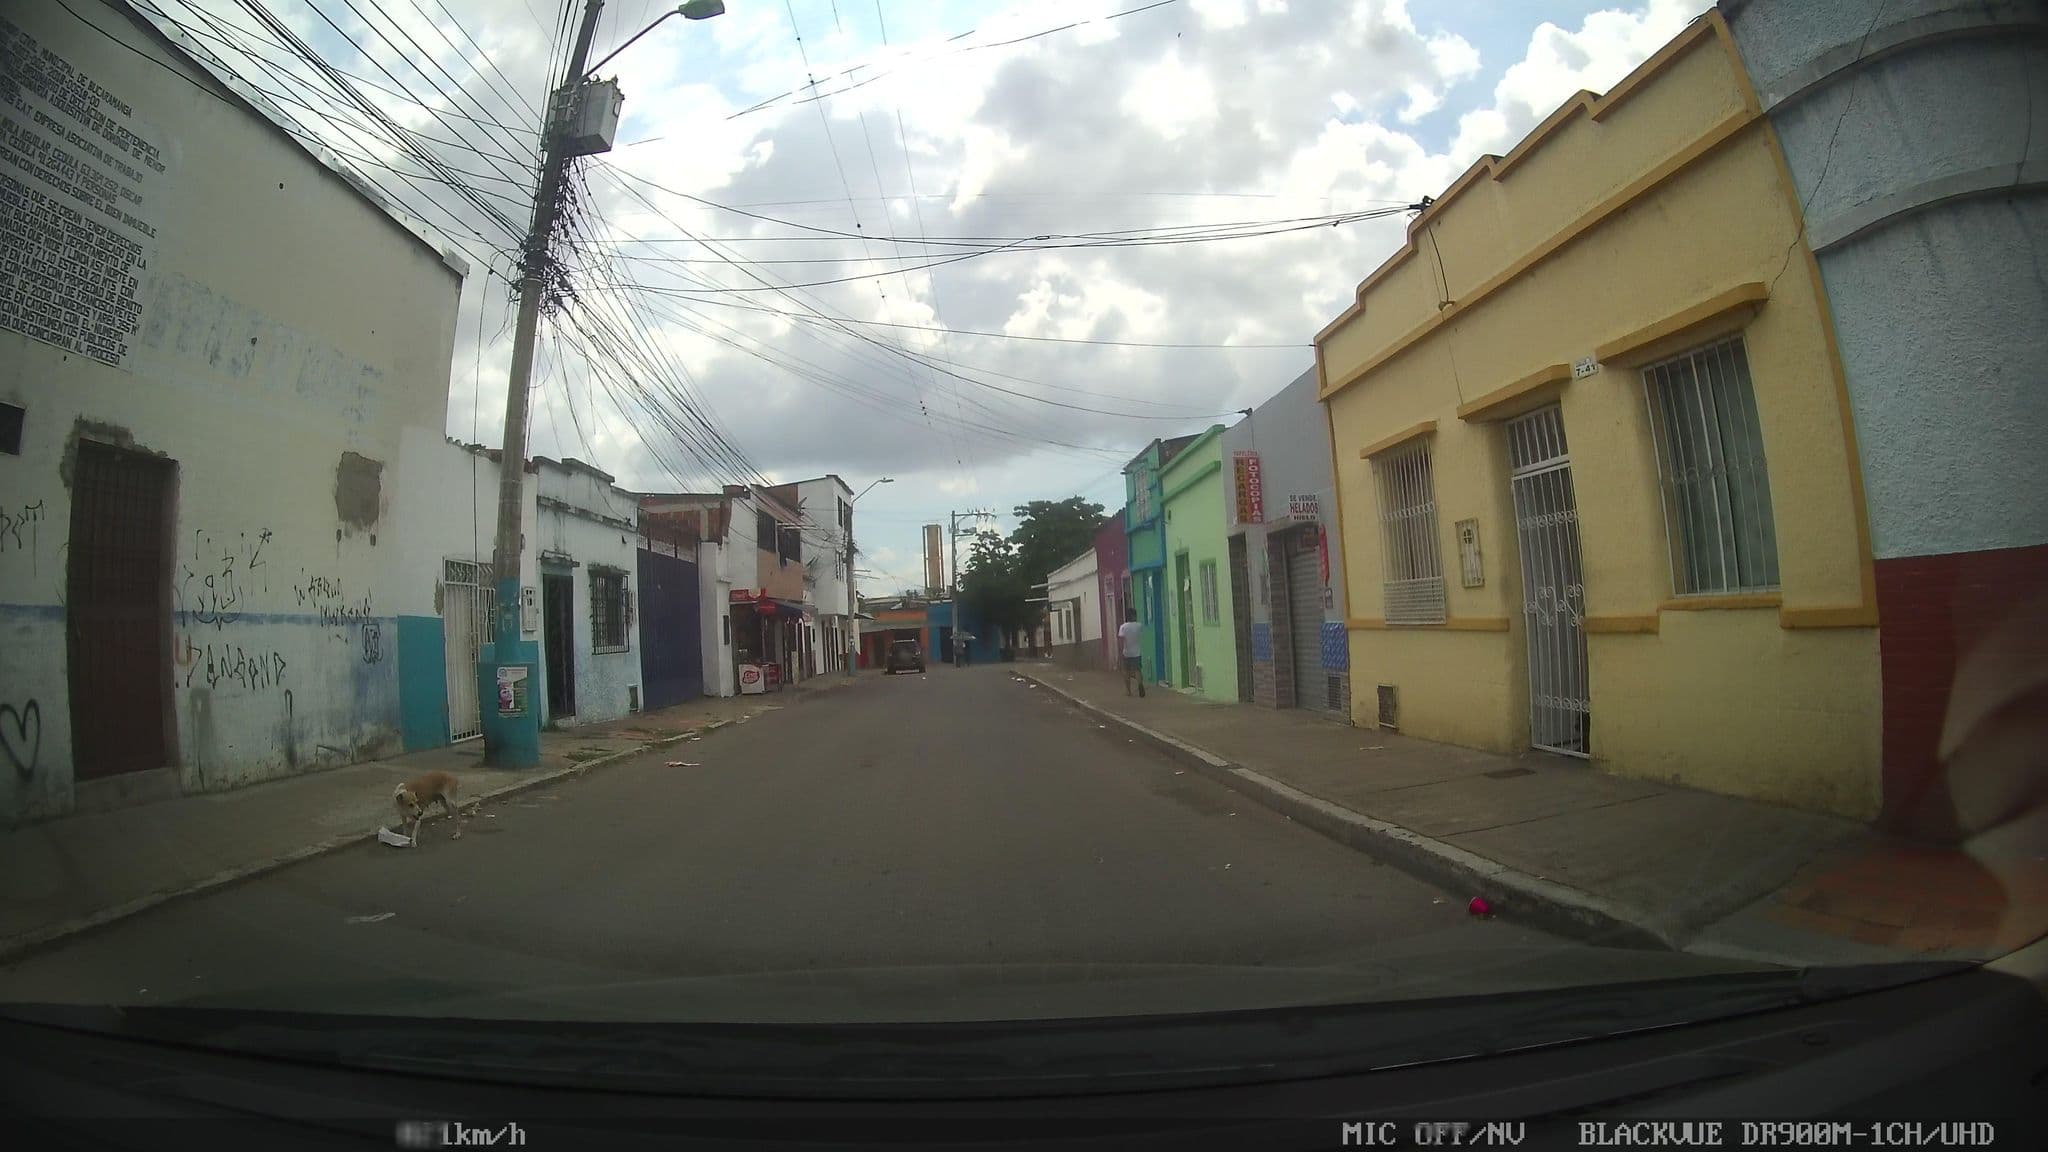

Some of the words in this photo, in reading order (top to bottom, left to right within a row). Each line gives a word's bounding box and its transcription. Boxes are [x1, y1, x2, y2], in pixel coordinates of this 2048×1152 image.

[40, 45, 75, 79] MUNICIPAL
[76, 71, 88, 87] DE
[87, 79, 132, 118] BUCARAMANGA
[58, 85, 70, 102] DE
[105, 116, 116, 132] DE
[8, 133, 36, 159] CEDULA
[74, 171, 81, 184] Y
[80, 174, 117, 205] PERSONAS
[33, 108, 65, 137] EMPRESA
[102, 151, 113, 166] DE
[113, 157, 143, 184] TRABAJO
[52, 146, 79, 170] CEDULA
[91, 119, 102, 135] DE
[131, 146, 142, 160] DE
[18, 156, 35, 175] CON
[33, 164, 72, 194] DERECHOS
[70, 184, 95, 207] SOBRE
[94, 197, 104, 211] EL
[104, 202, 122, 221] BIEN
[12, 207, 65, 242] BUCARAMANGA
[65, 233, 119, 268] DEPARTAMENTO
[119, 260, 130, 274] DE
[29, 202, 49, 222] LOTE
[49, 212, 61, 227] DE
[61, 218, 94, 244] TERRENO
[94, 235, 125, 259] UBICADO
[125, 250, 136, 265] EN
[136, 256, 147, 270] LA
[30, 189, 47, 207] QUE
[46, 197, 58, 213] SE
[58, 203, 82, 225] CREAN
[82, 216, 107, 237] TENER
[106, 228, 143, 256] DERECHOS
[8, 247, 20, 262] EN
[30, 256, 47, 273] MTS
[46, 263, 62, 280] CON
[62, 270, 105, 298] PROPIEDAD
[104, 289, 116, 303] DE
[116, 294, 143, 315] BENITO
[26, 227, 43, 245] QUE
[43, 235, 62, 253] MIDE
[61, 244, 67, 256] Y
[103, 264, 128, 284] NORTE
[127, 275, 138, 289] EN
[34, 245, 41, 258] 7
[40, 247, 46, 260] Y
[45, 250, 56, 265] 10
[57, 255, 79, 274] ESTE
[77, 264, 89, 279] EN
[89, 270, 101, 284] 20
[100, 275, 117, 291] MTS
[119, 284, 135, 299] CON
[3, 259, 21, 275] CON
[20, 266, 63, 293] PROPIEDAD
[63, 284, 76, 298] DE
[76, 289, 115, 314] FRANCISCO
[113, 305, 137, 324] REYES
[12, 290, 26, 305] EN
[24, 295, 62, 319] CATASTRO
[62, 309, 80, 325] CON
[93, 321, 124, 342] NUMERO
[17, 278, 30, 293] DE
[52, 292, 91, 317] LINDEROS
[91, 308, 97, 320] Y
[96, 310, 116, 327] AREA
[10, 316, 28, 333] QUE
[26, 322, 73, 348] CONCURRAN
[73, 339, 84, 352] AL
[21, 307, 78, 337] INSTRUMENTOS
[77, 328, 116, 351] PUBLICOS
[116, 343, 128, 356] DE
[1248, 458, 1262, 522] FOTOCOPIAS
[1290, 502, 1319, 514] HELADOS
